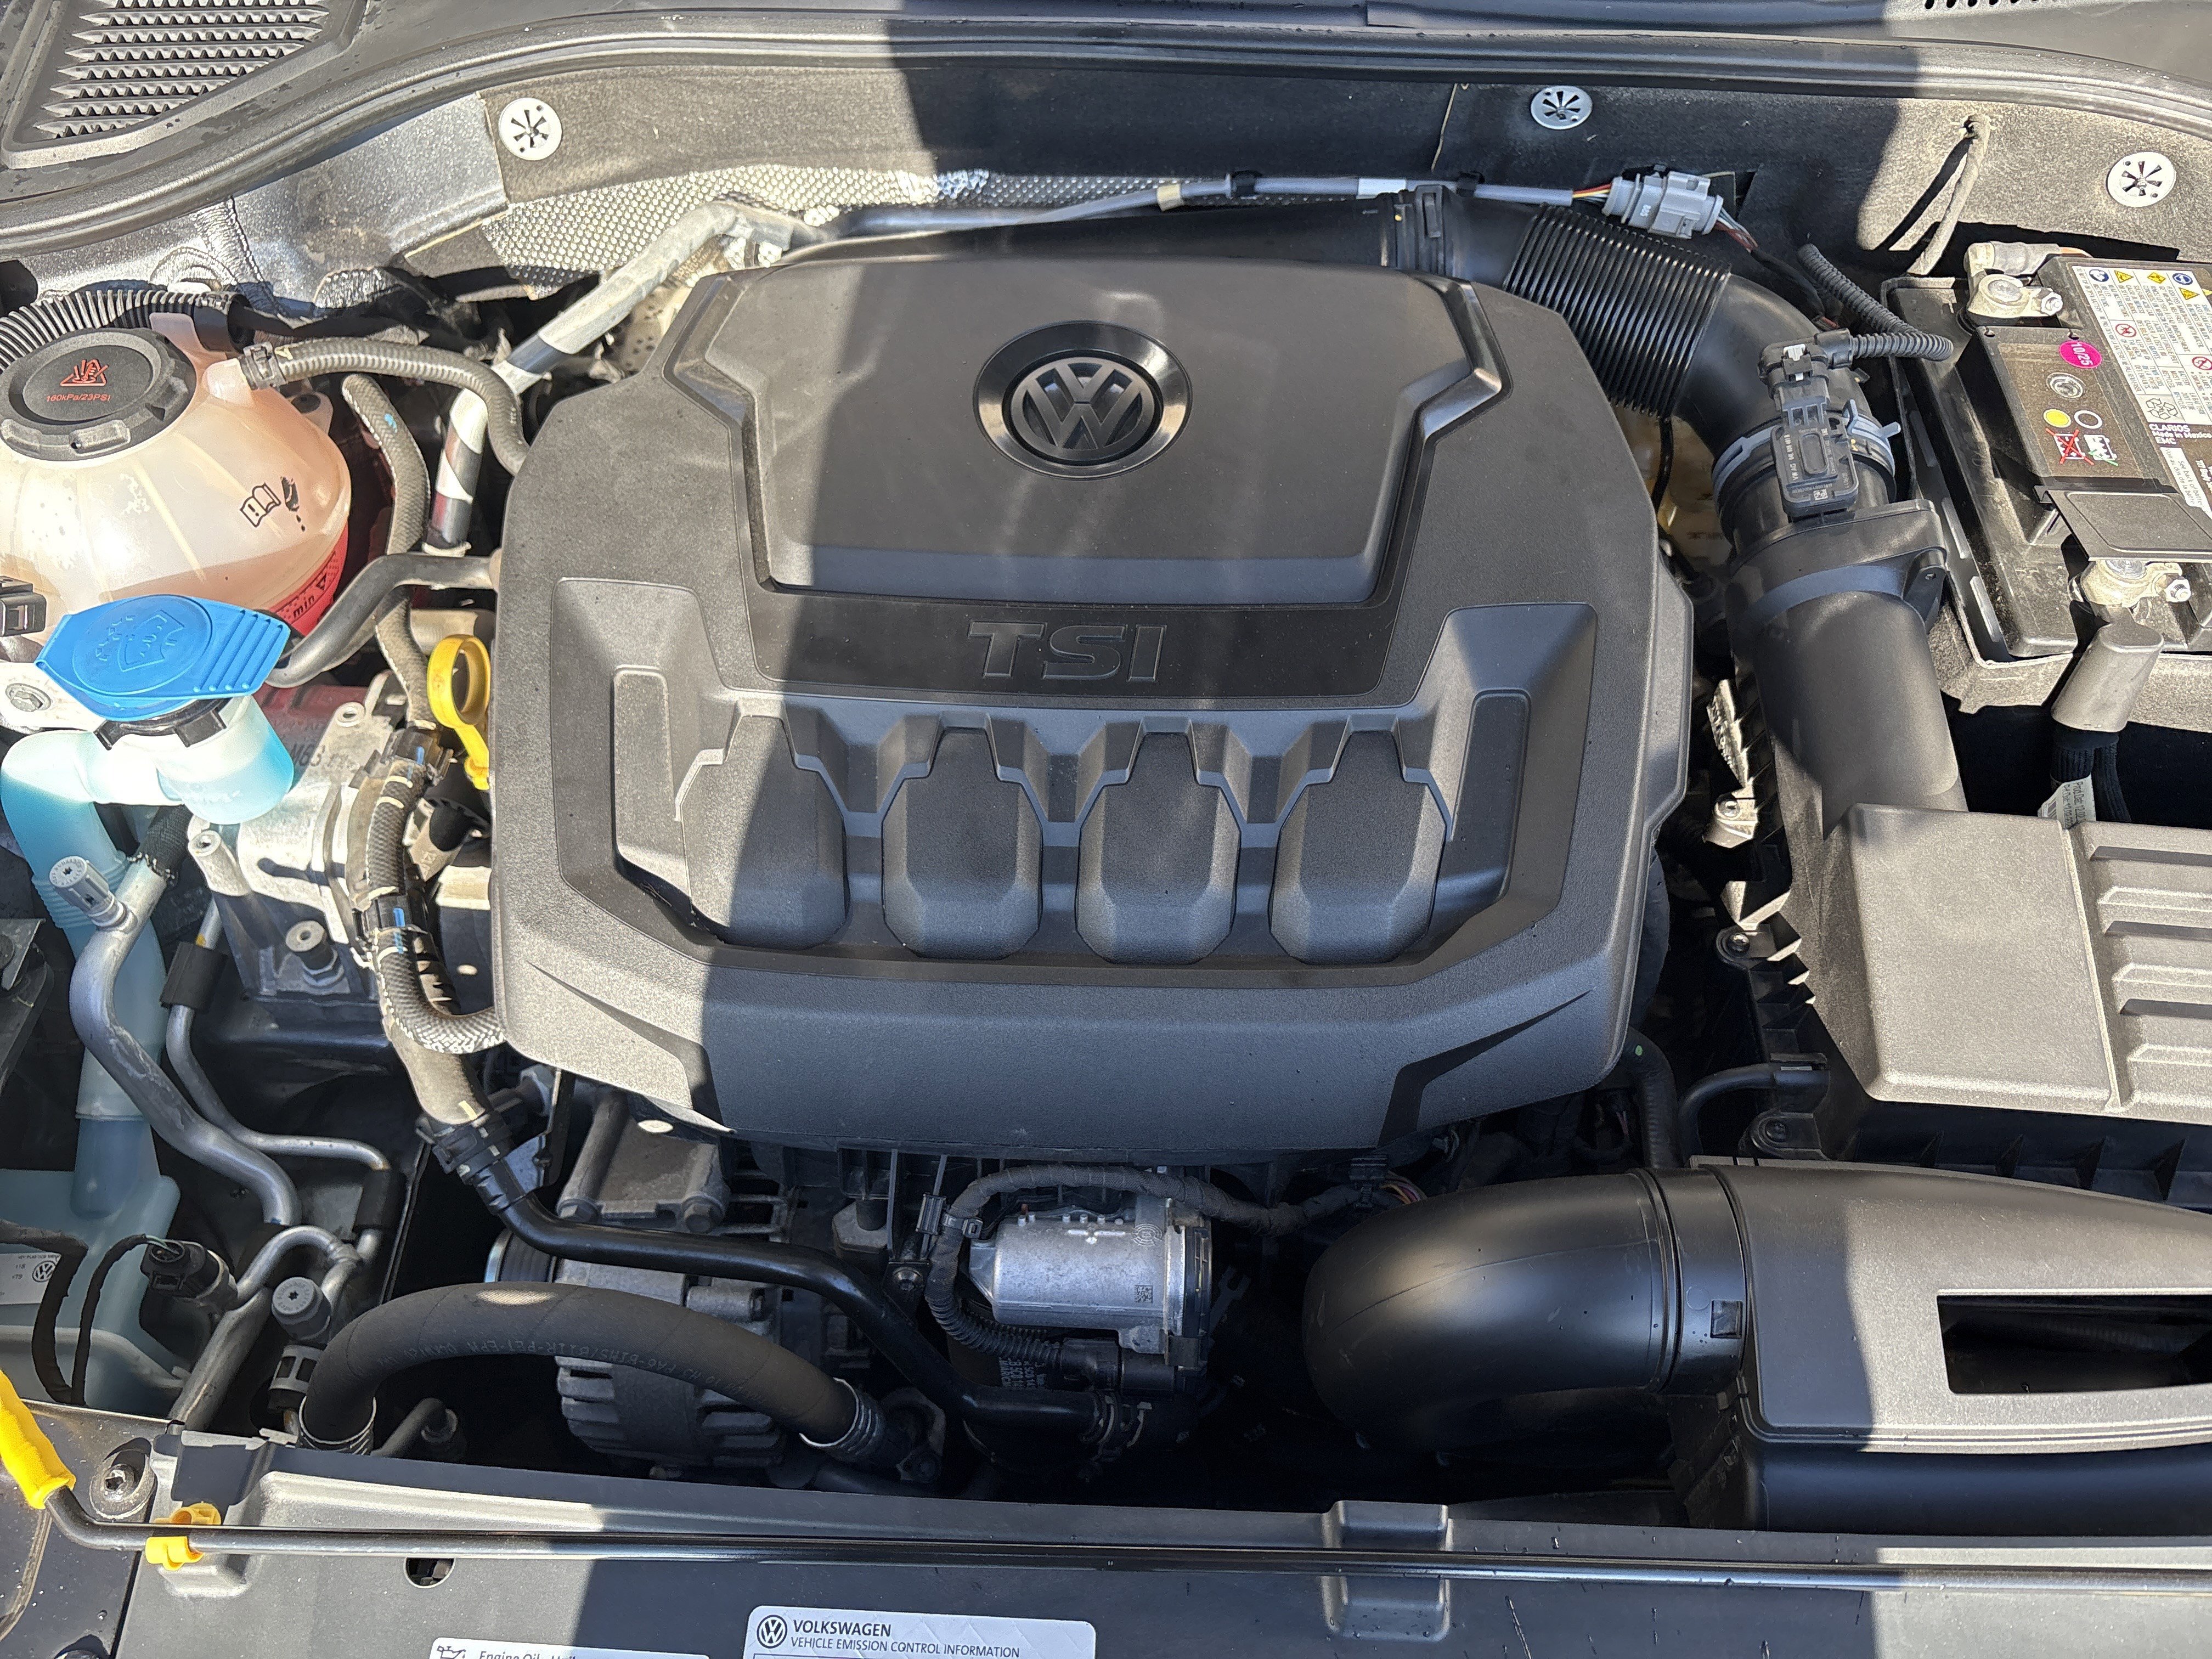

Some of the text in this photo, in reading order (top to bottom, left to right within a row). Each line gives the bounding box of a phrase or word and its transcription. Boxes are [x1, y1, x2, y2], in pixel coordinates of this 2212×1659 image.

[2070, 342, 2094, 365] 10/25
[46, 393, 111, 402] 160kPa/23PSI
[2148, 424, 2191, 432] CLARIOS
[2154, 437, 2177, 445] EMC
[1790, 462, 1798, 480] VW AG
[2172, 466, 2183, 476] dos
[2177, 460, 2188, 469] See
[2182, 470, 2194, 483] back
[293, 595, 314, 618] min
[967, 620, 1167, 683] TSI
[793, 1620, 891, 1637] VOLKSWAGEN
[791, 1637, 1020, 1657] VEHICLE EMISSION CONTROL INFORMATION
